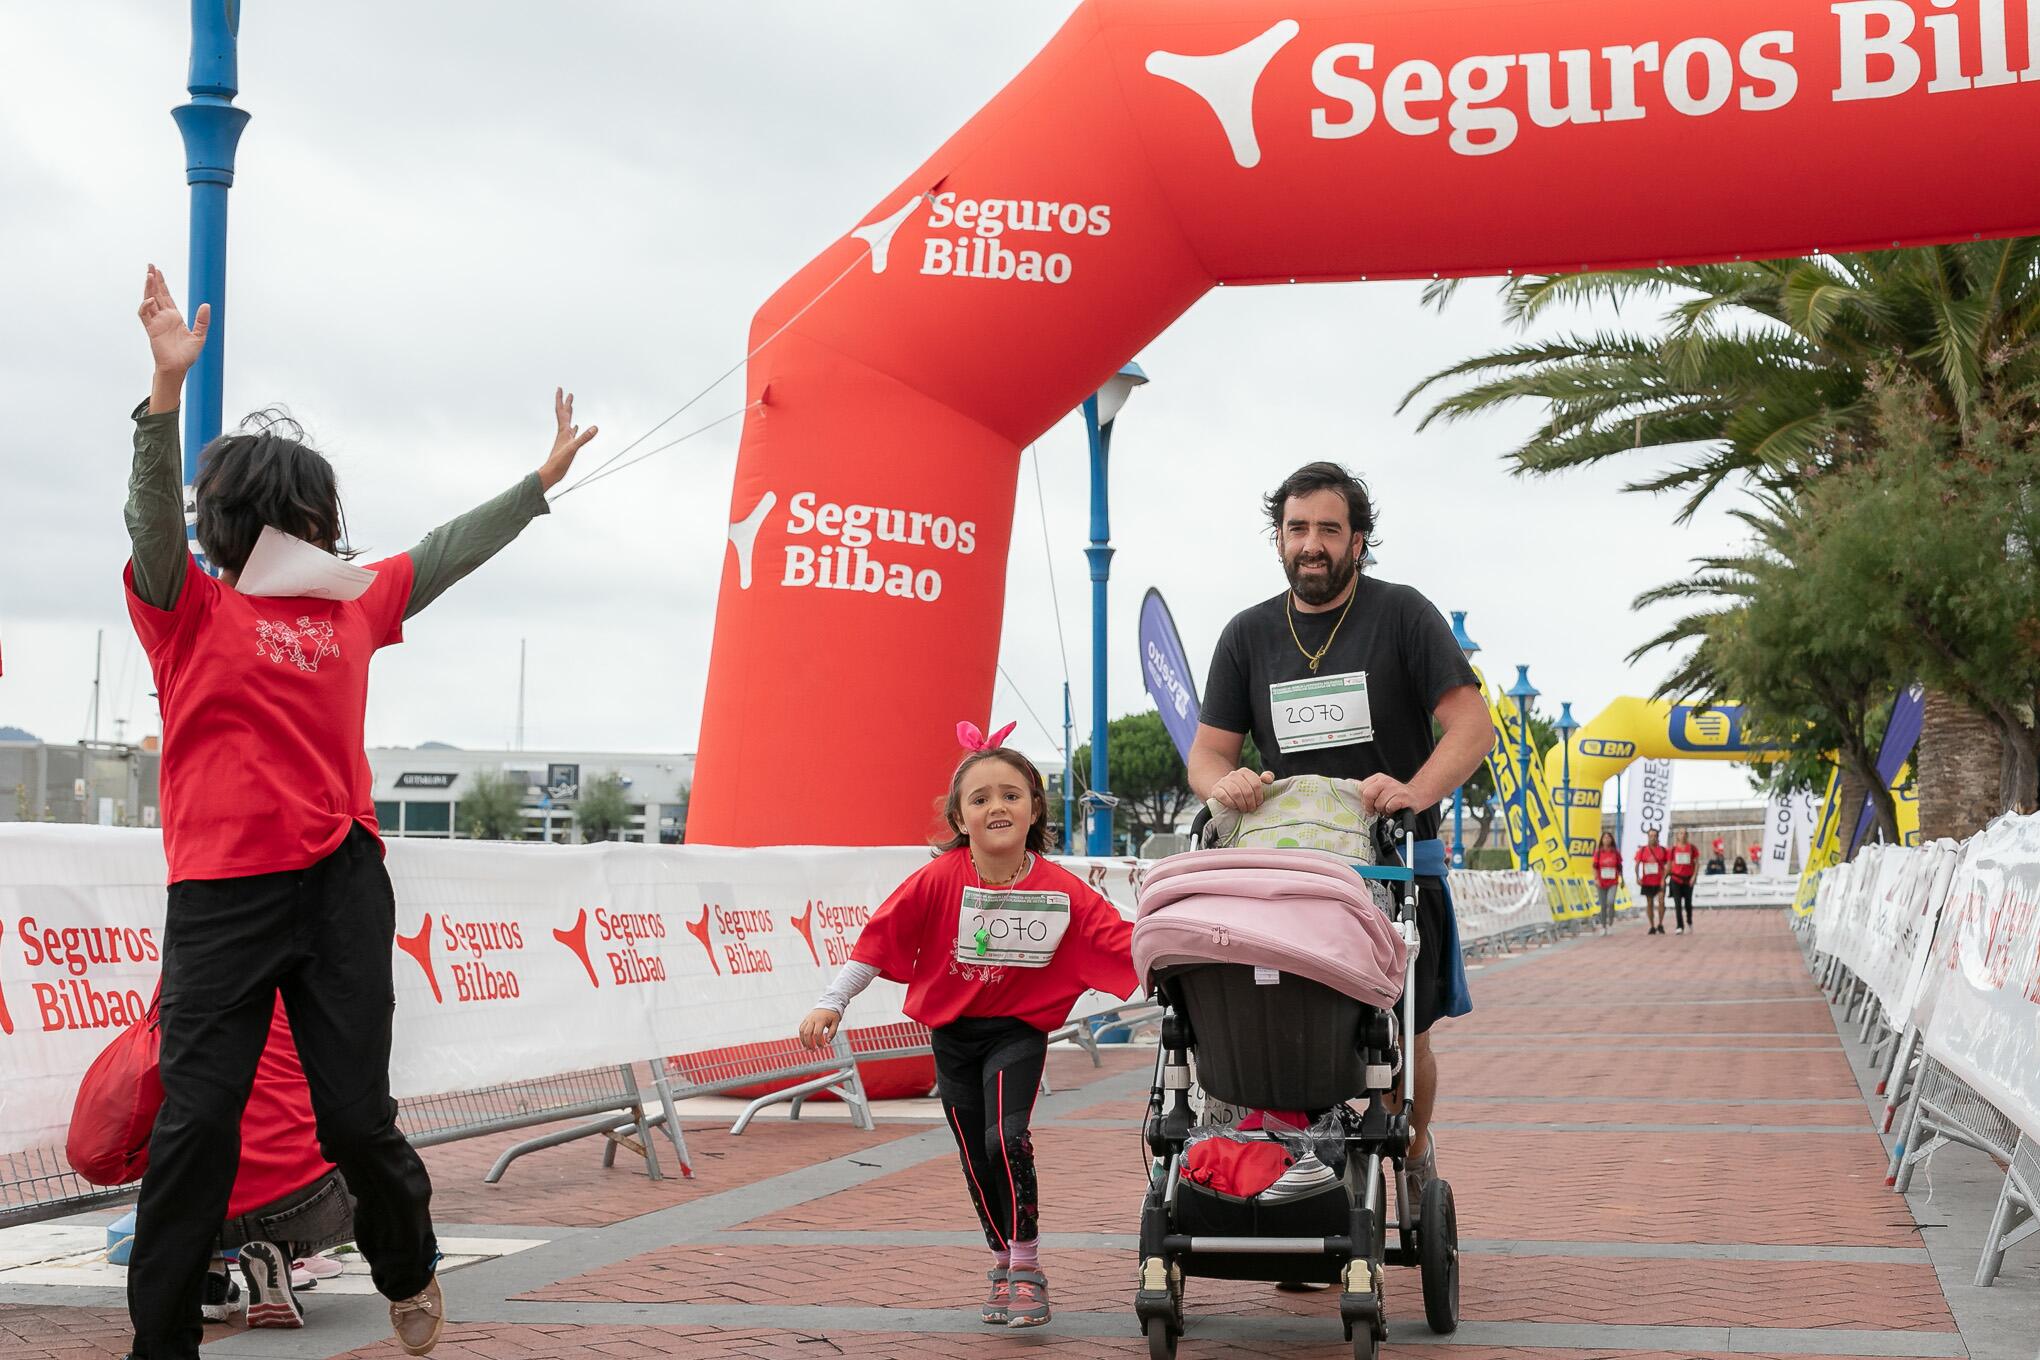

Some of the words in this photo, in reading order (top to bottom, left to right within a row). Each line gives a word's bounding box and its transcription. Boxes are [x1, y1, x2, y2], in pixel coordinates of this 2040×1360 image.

[1310, 30, 1798, 157] Seguros
[928, 192, 1111, 237] Seguros
[919, 236, 1073, 284] Bilbao
[786, 491, 976, 554] Seguros
[780, 545, 942, 602] Bilbao
[1285, 704, 1344, 723] 2070
[1603, 742, 1632, 756] BM
[1573, 790, 1599, 806] BM
[1640, 758, 1656, 834] CORRE
[1777, 794, 1792, 835] COR
[1569, 840, 1595, 855] BM
[1773, 840, 1787, 860] EL
[442, 914, 524, 958] Seguros
[595, 908, 666, 947] Seguros
[715, 904, 774, 940] Seguros
[817, 900, 871, 934] Seguros
[973, 915, 1047, 941] 2070
[18, 916, 160, 976] Seguros
[724, 943, 773, 974] Bilbao
[824, 936, 855, 965] Bilb
[452, 962, 520, 1002] Bilbao
[607, 949, 667, 985] Bilbao
[32, 979, 146, 1032] Bilbao
